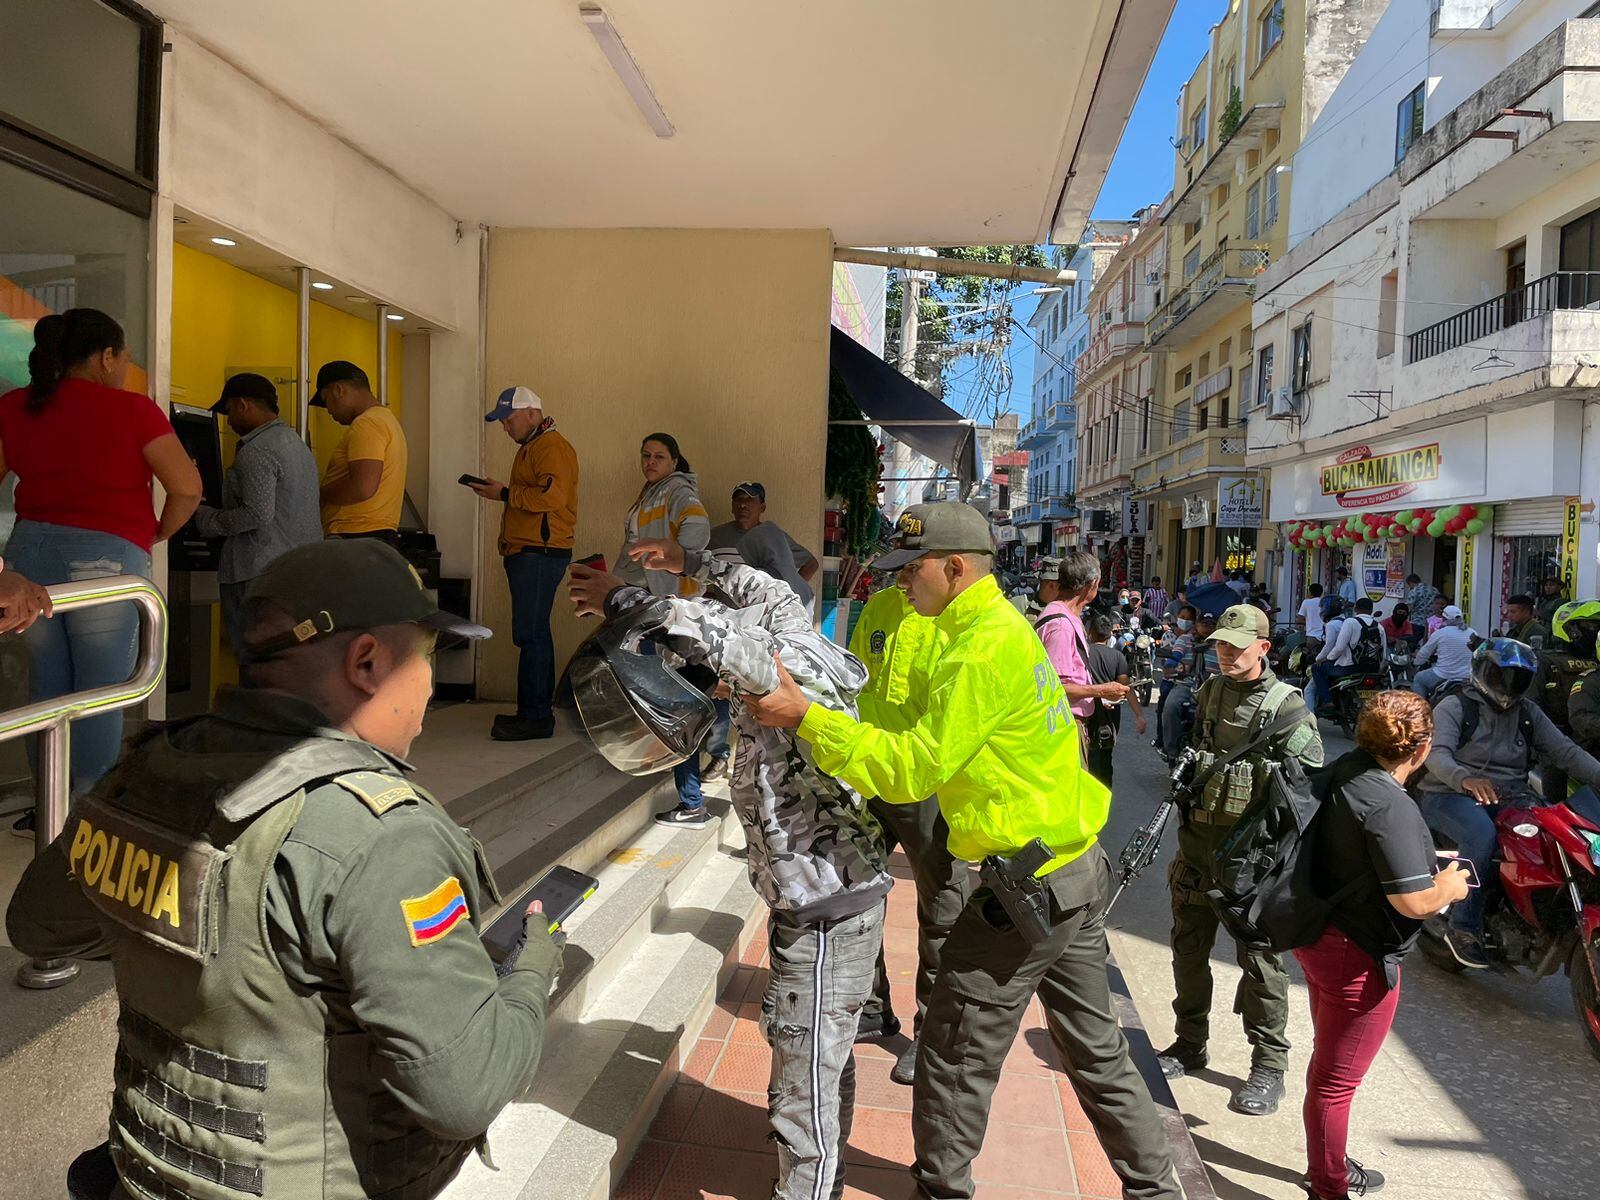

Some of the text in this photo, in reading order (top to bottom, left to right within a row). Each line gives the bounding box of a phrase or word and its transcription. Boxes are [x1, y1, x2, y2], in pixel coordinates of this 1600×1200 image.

[1323, 448, 1434, 493] BUCARAMANGA
[1340, 446, 1367, 460] CALZADO
[69, 819, 180, 928] POLICIA
